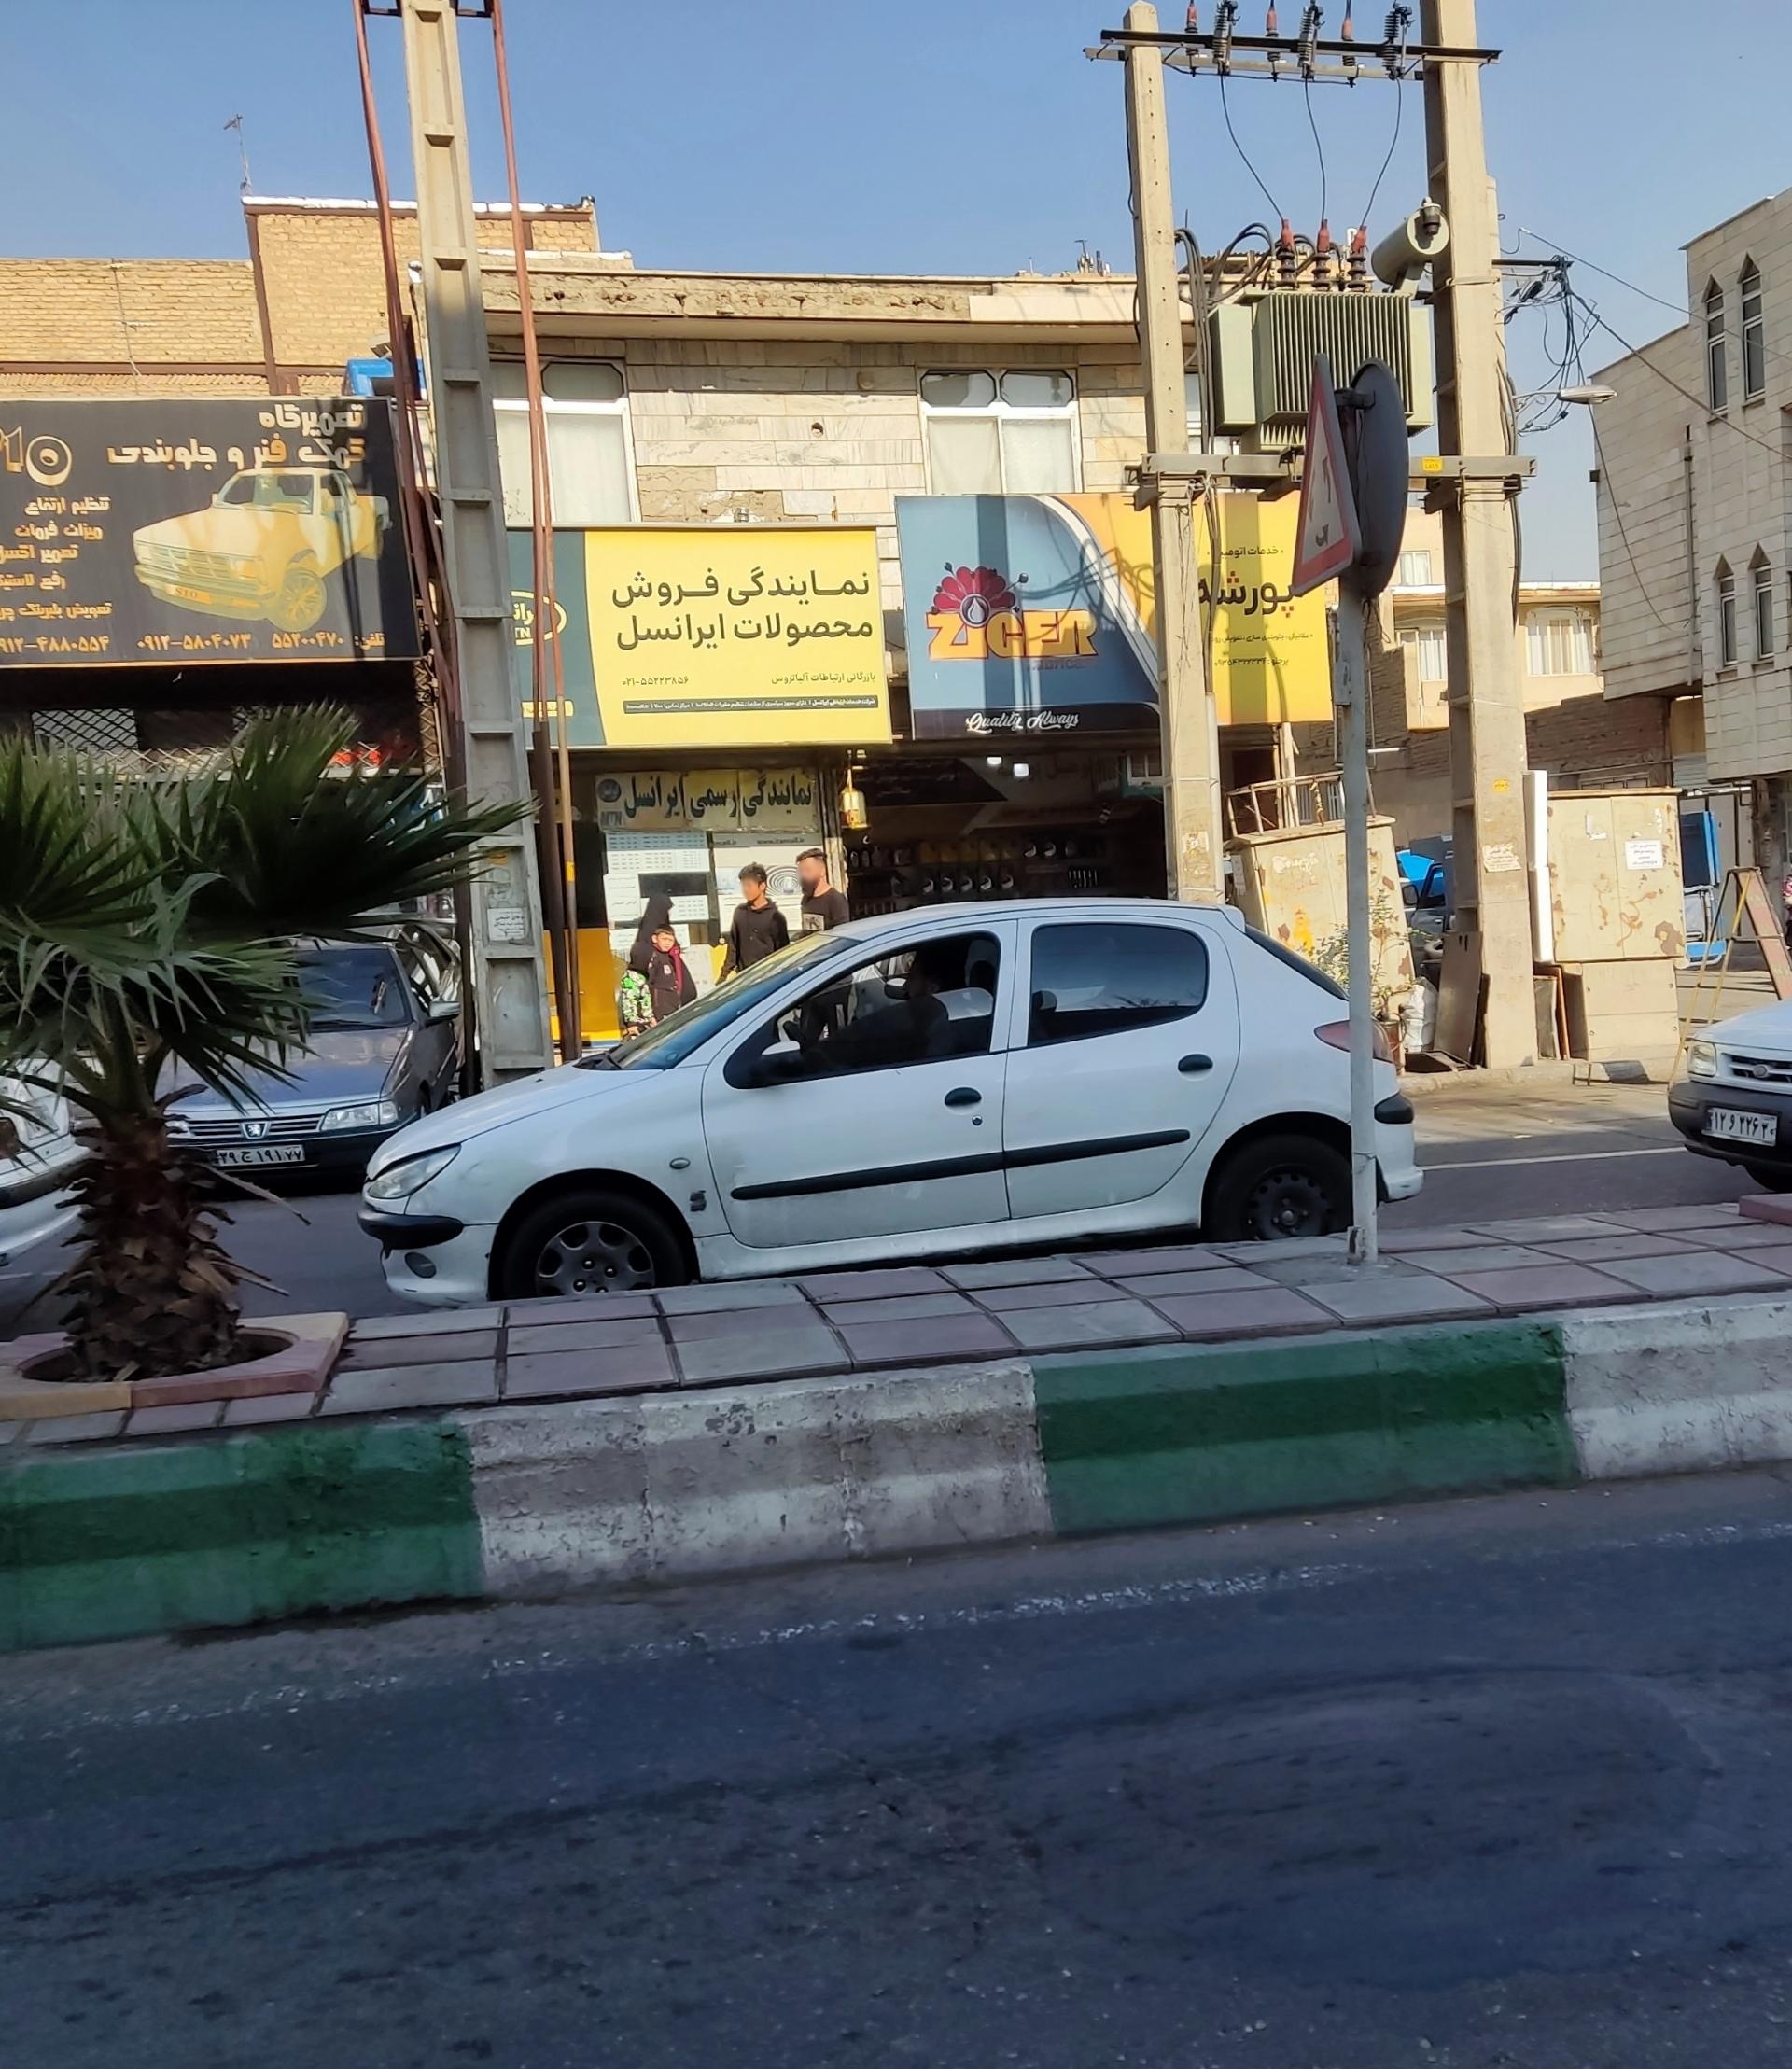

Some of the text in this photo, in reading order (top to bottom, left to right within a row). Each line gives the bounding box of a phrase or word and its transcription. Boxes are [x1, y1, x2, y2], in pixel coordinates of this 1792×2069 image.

[259, 403, 364, 437] تعمیرگاه
[106, 437, 217, 471] جلوبندی
[227, 446, 245, 471] و
[253, 432, 288, 471] فنر
[24, 496, 111, 516] تنظیم ارتفاع
[612, 566, 870, 608] نمایندگی فروش
[617, 612, 873, 650] محصولات ایرانسل
[965, 710, 1080, 734] Quality Always
[624, 776, 686, 818] ایرانسل
[743, 774, 812, 818] نمایندگی
